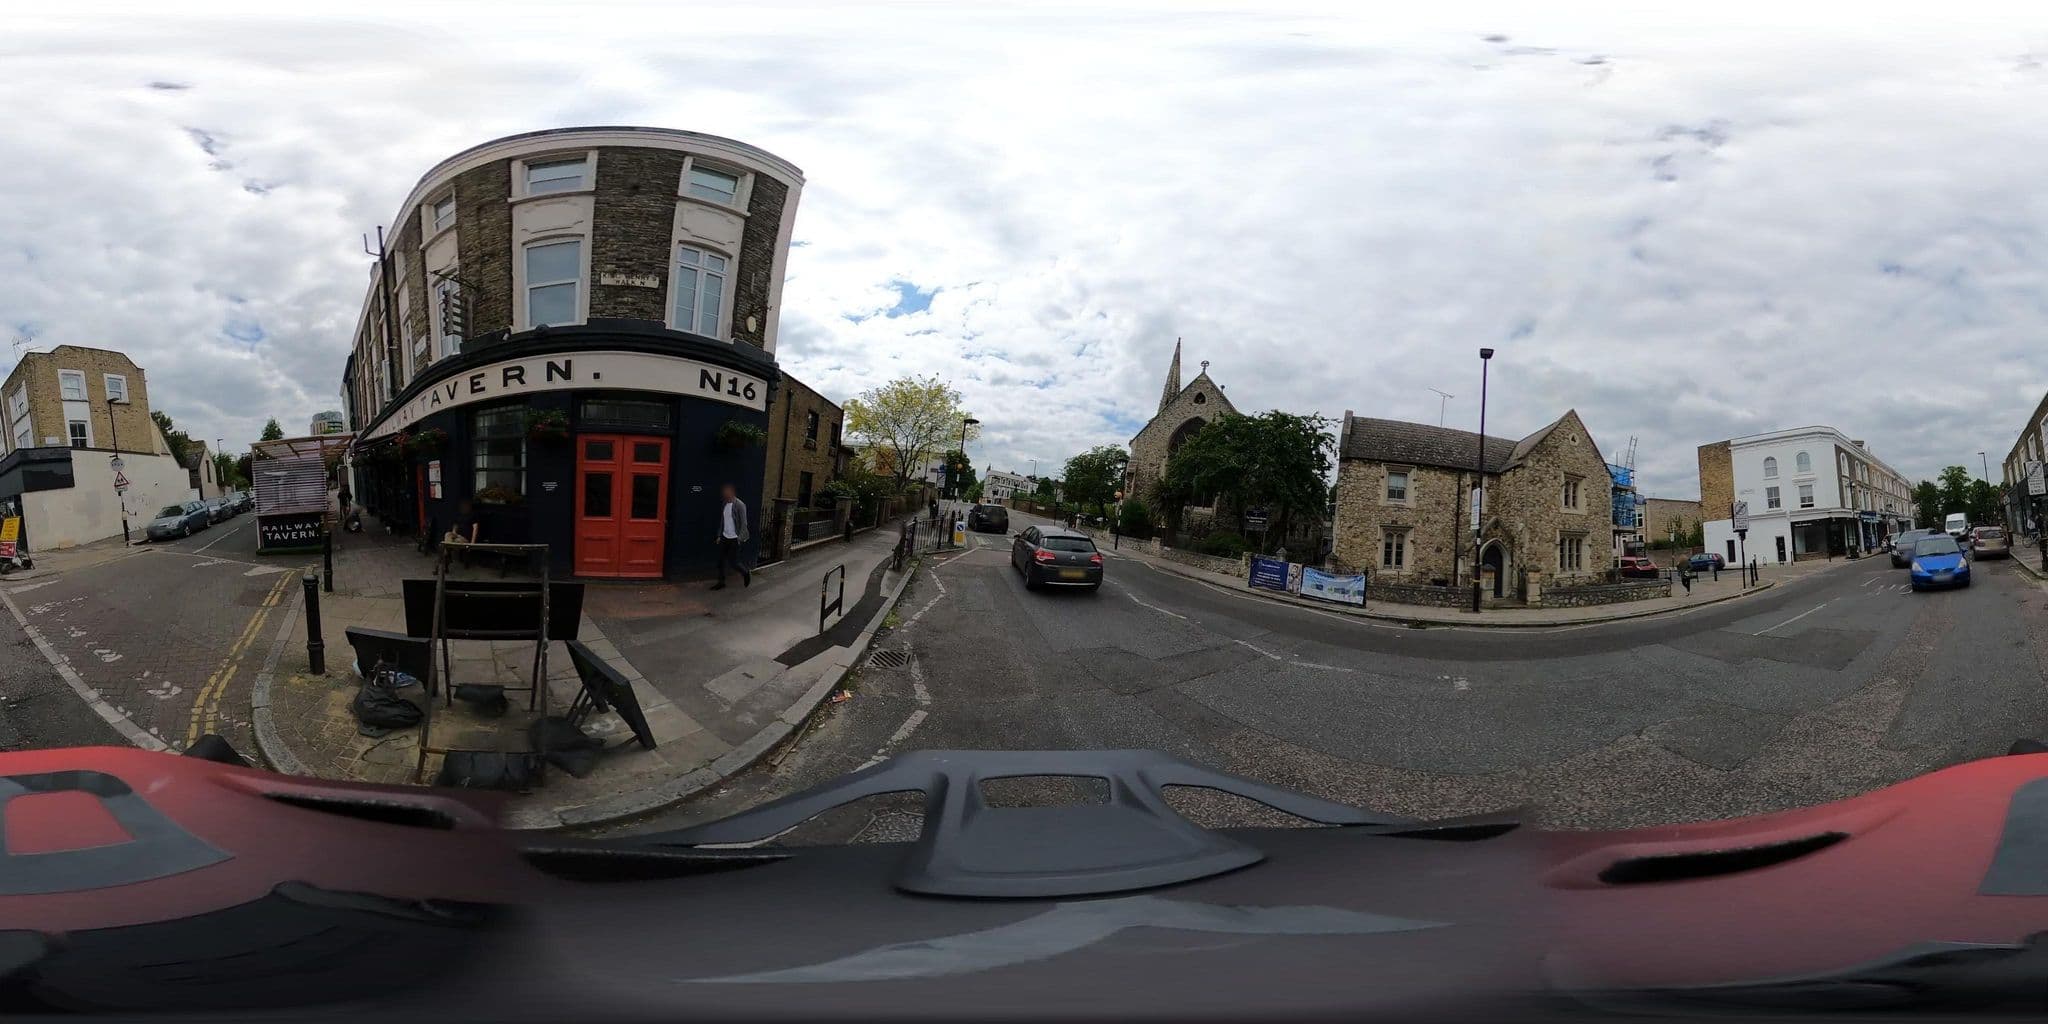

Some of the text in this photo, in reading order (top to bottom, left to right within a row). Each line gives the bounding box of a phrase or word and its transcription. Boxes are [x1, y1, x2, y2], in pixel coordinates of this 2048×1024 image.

[699, 368, 756, 401] N16
[262, 522, 320, 532] RAILWAY
[266, 530, 319, 540] TAVERN.
